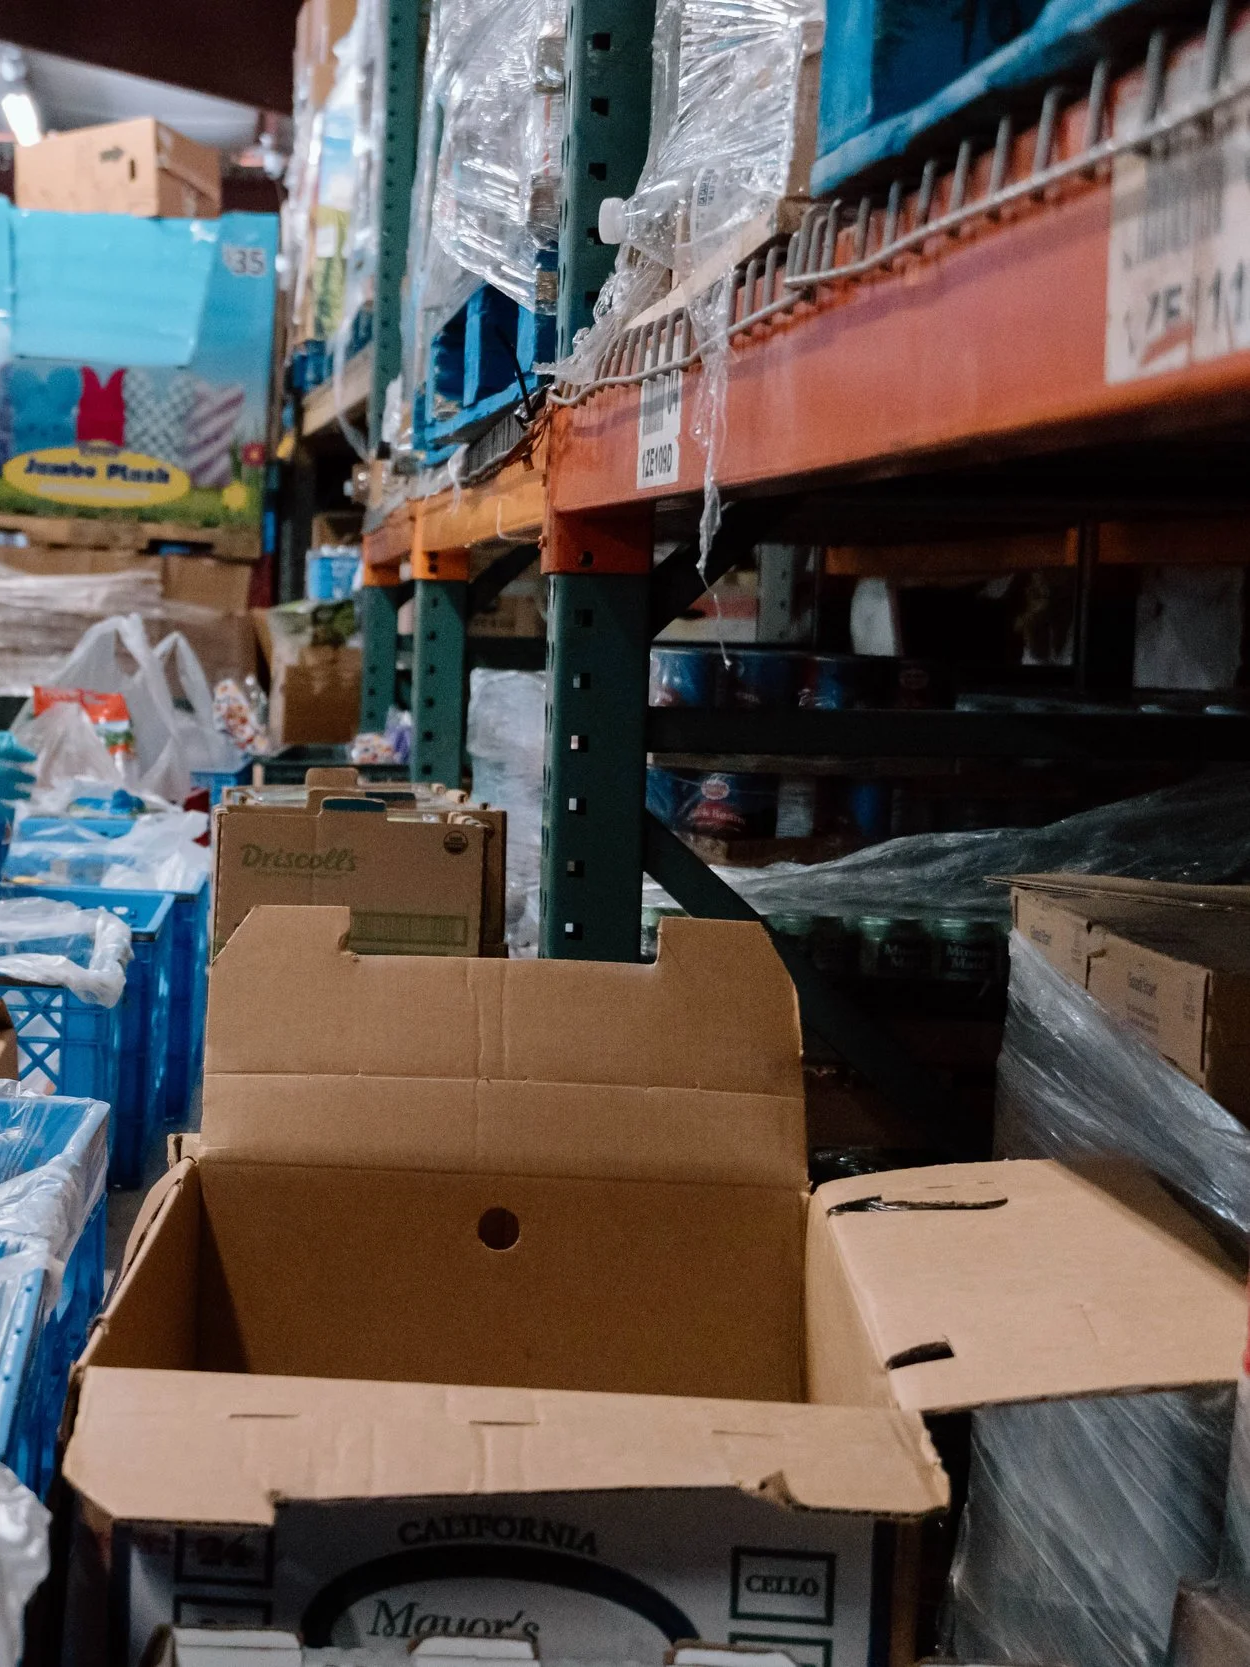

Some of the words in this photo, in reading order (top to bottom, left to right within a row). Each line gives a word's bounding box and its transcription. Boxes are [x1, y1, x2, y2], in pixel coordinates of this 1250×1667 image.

[240, 842, 356, 872] Driscoll's
[397, 1512, 598, 1557] CALIFORNIA
[745, 1574, 820, 1597] CELLO
